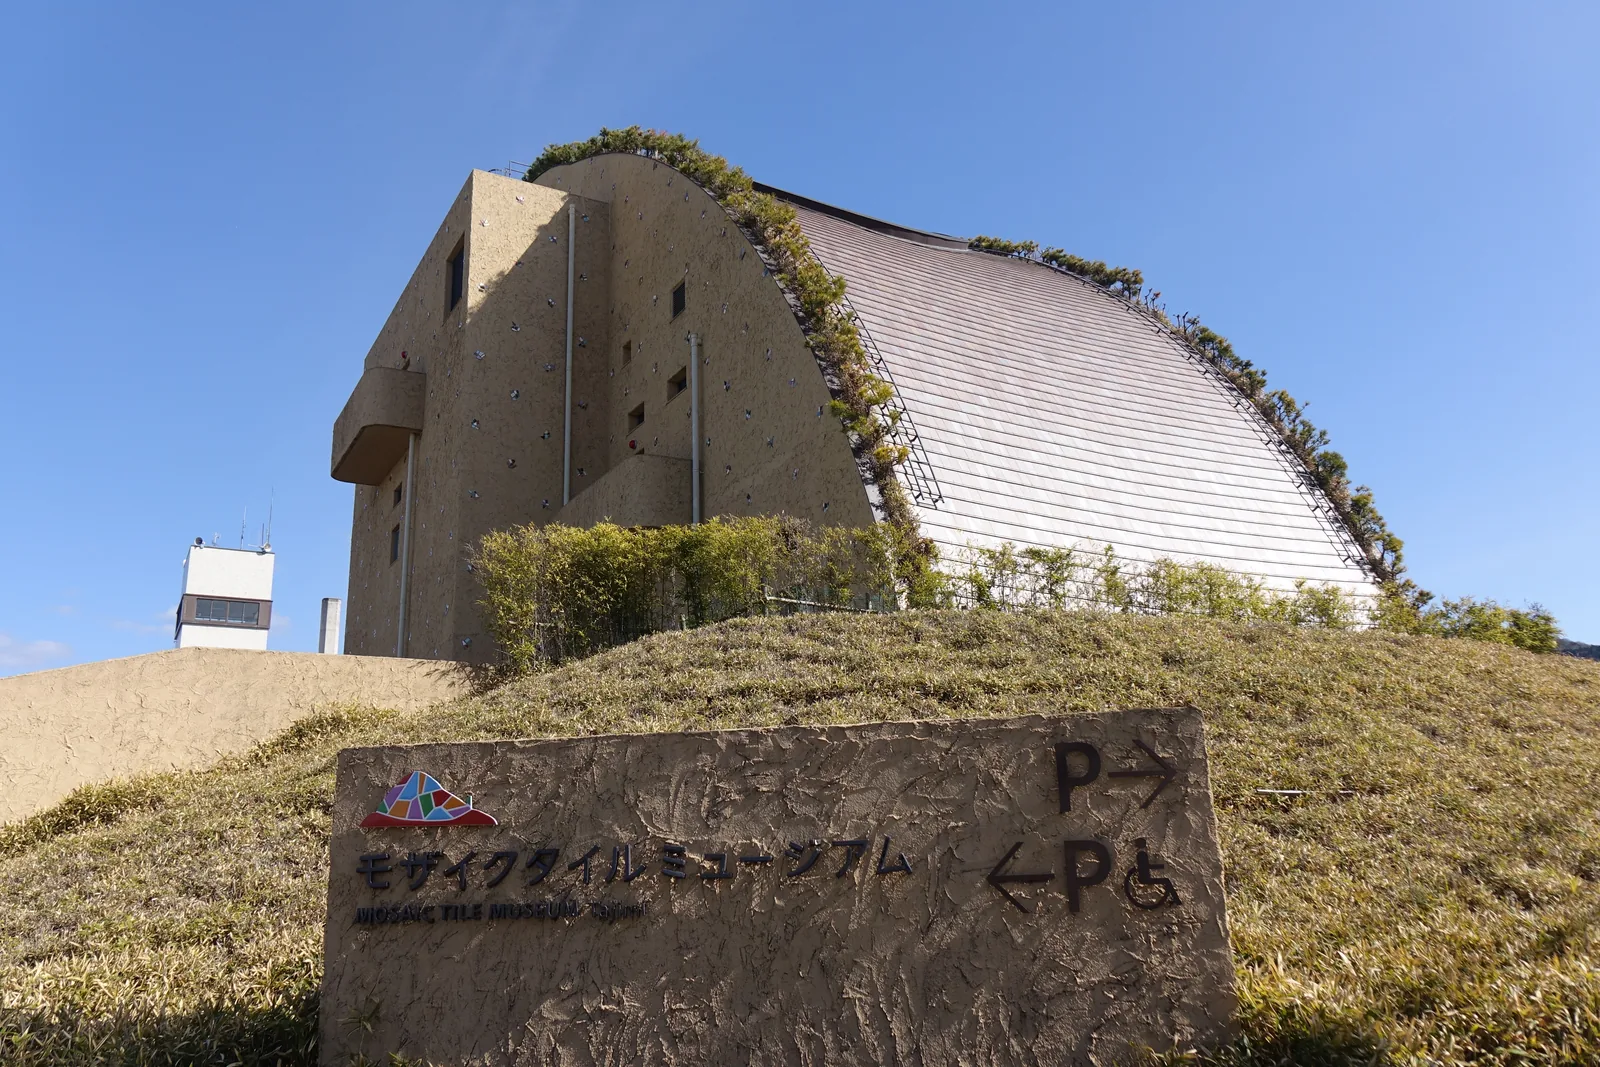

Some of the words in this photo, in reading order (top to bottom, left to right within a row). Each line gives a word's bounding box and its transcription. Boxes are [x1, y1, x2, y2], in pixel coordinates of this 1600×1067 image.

[1055, 742, 1101, 814] P
[356, 835, 913, 891] モザイクタイルミュージアム
[1064, 840, 1111, 913] P
[356, 904, 434, 925] MOSAIC
[439, 902, 482, 921] TILE
[489, 900, 580, 920] MUSEUM
